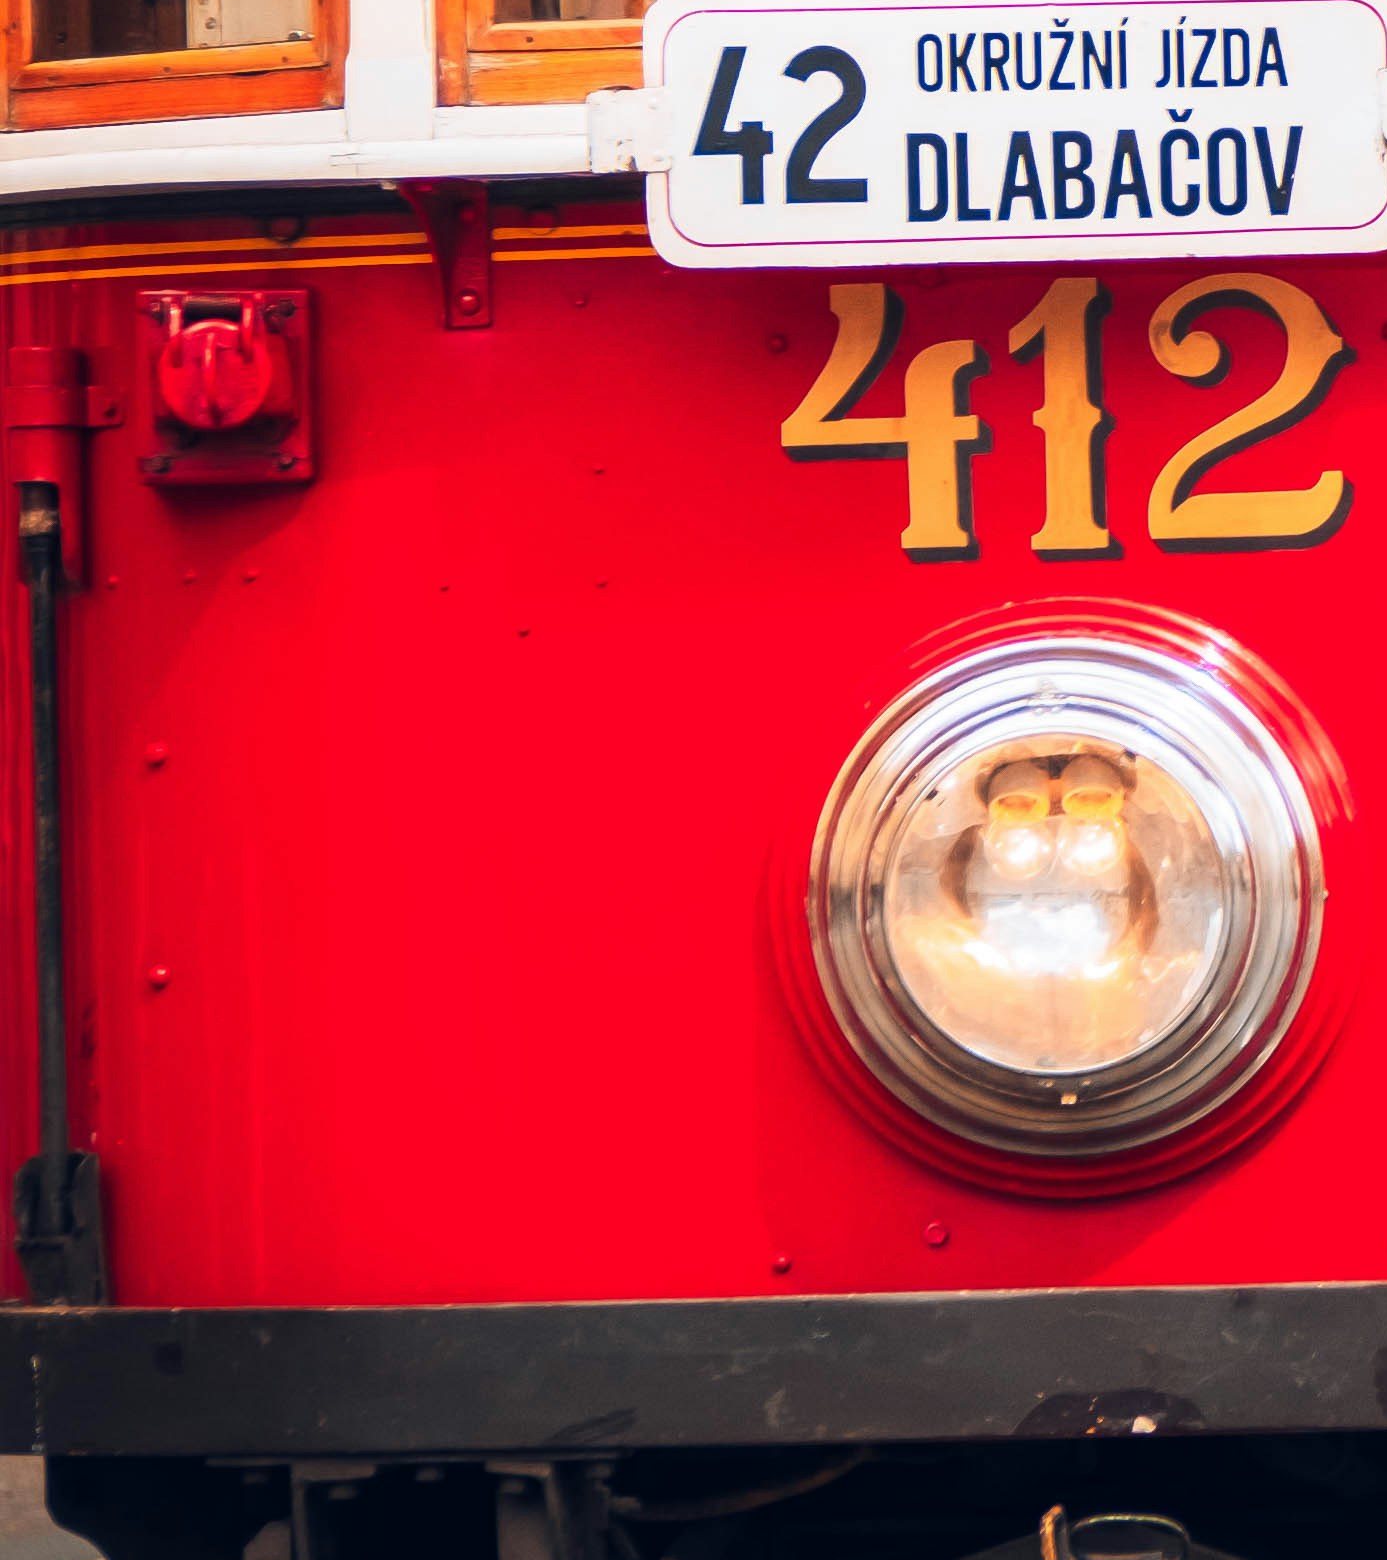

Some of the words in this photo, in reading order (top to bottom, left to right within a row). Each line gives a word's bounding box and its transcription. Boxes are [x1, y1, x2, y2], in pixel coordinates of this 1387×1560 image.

[916, 17, 1129, 92] OKRUŽNÍ
[1155, 16, 1290, 89] JÍZDA
[691, 45, 869, 205] 42
[906, 108, 1304, 222] DLABAČOV
[780, 272, 1357, 563] 412
